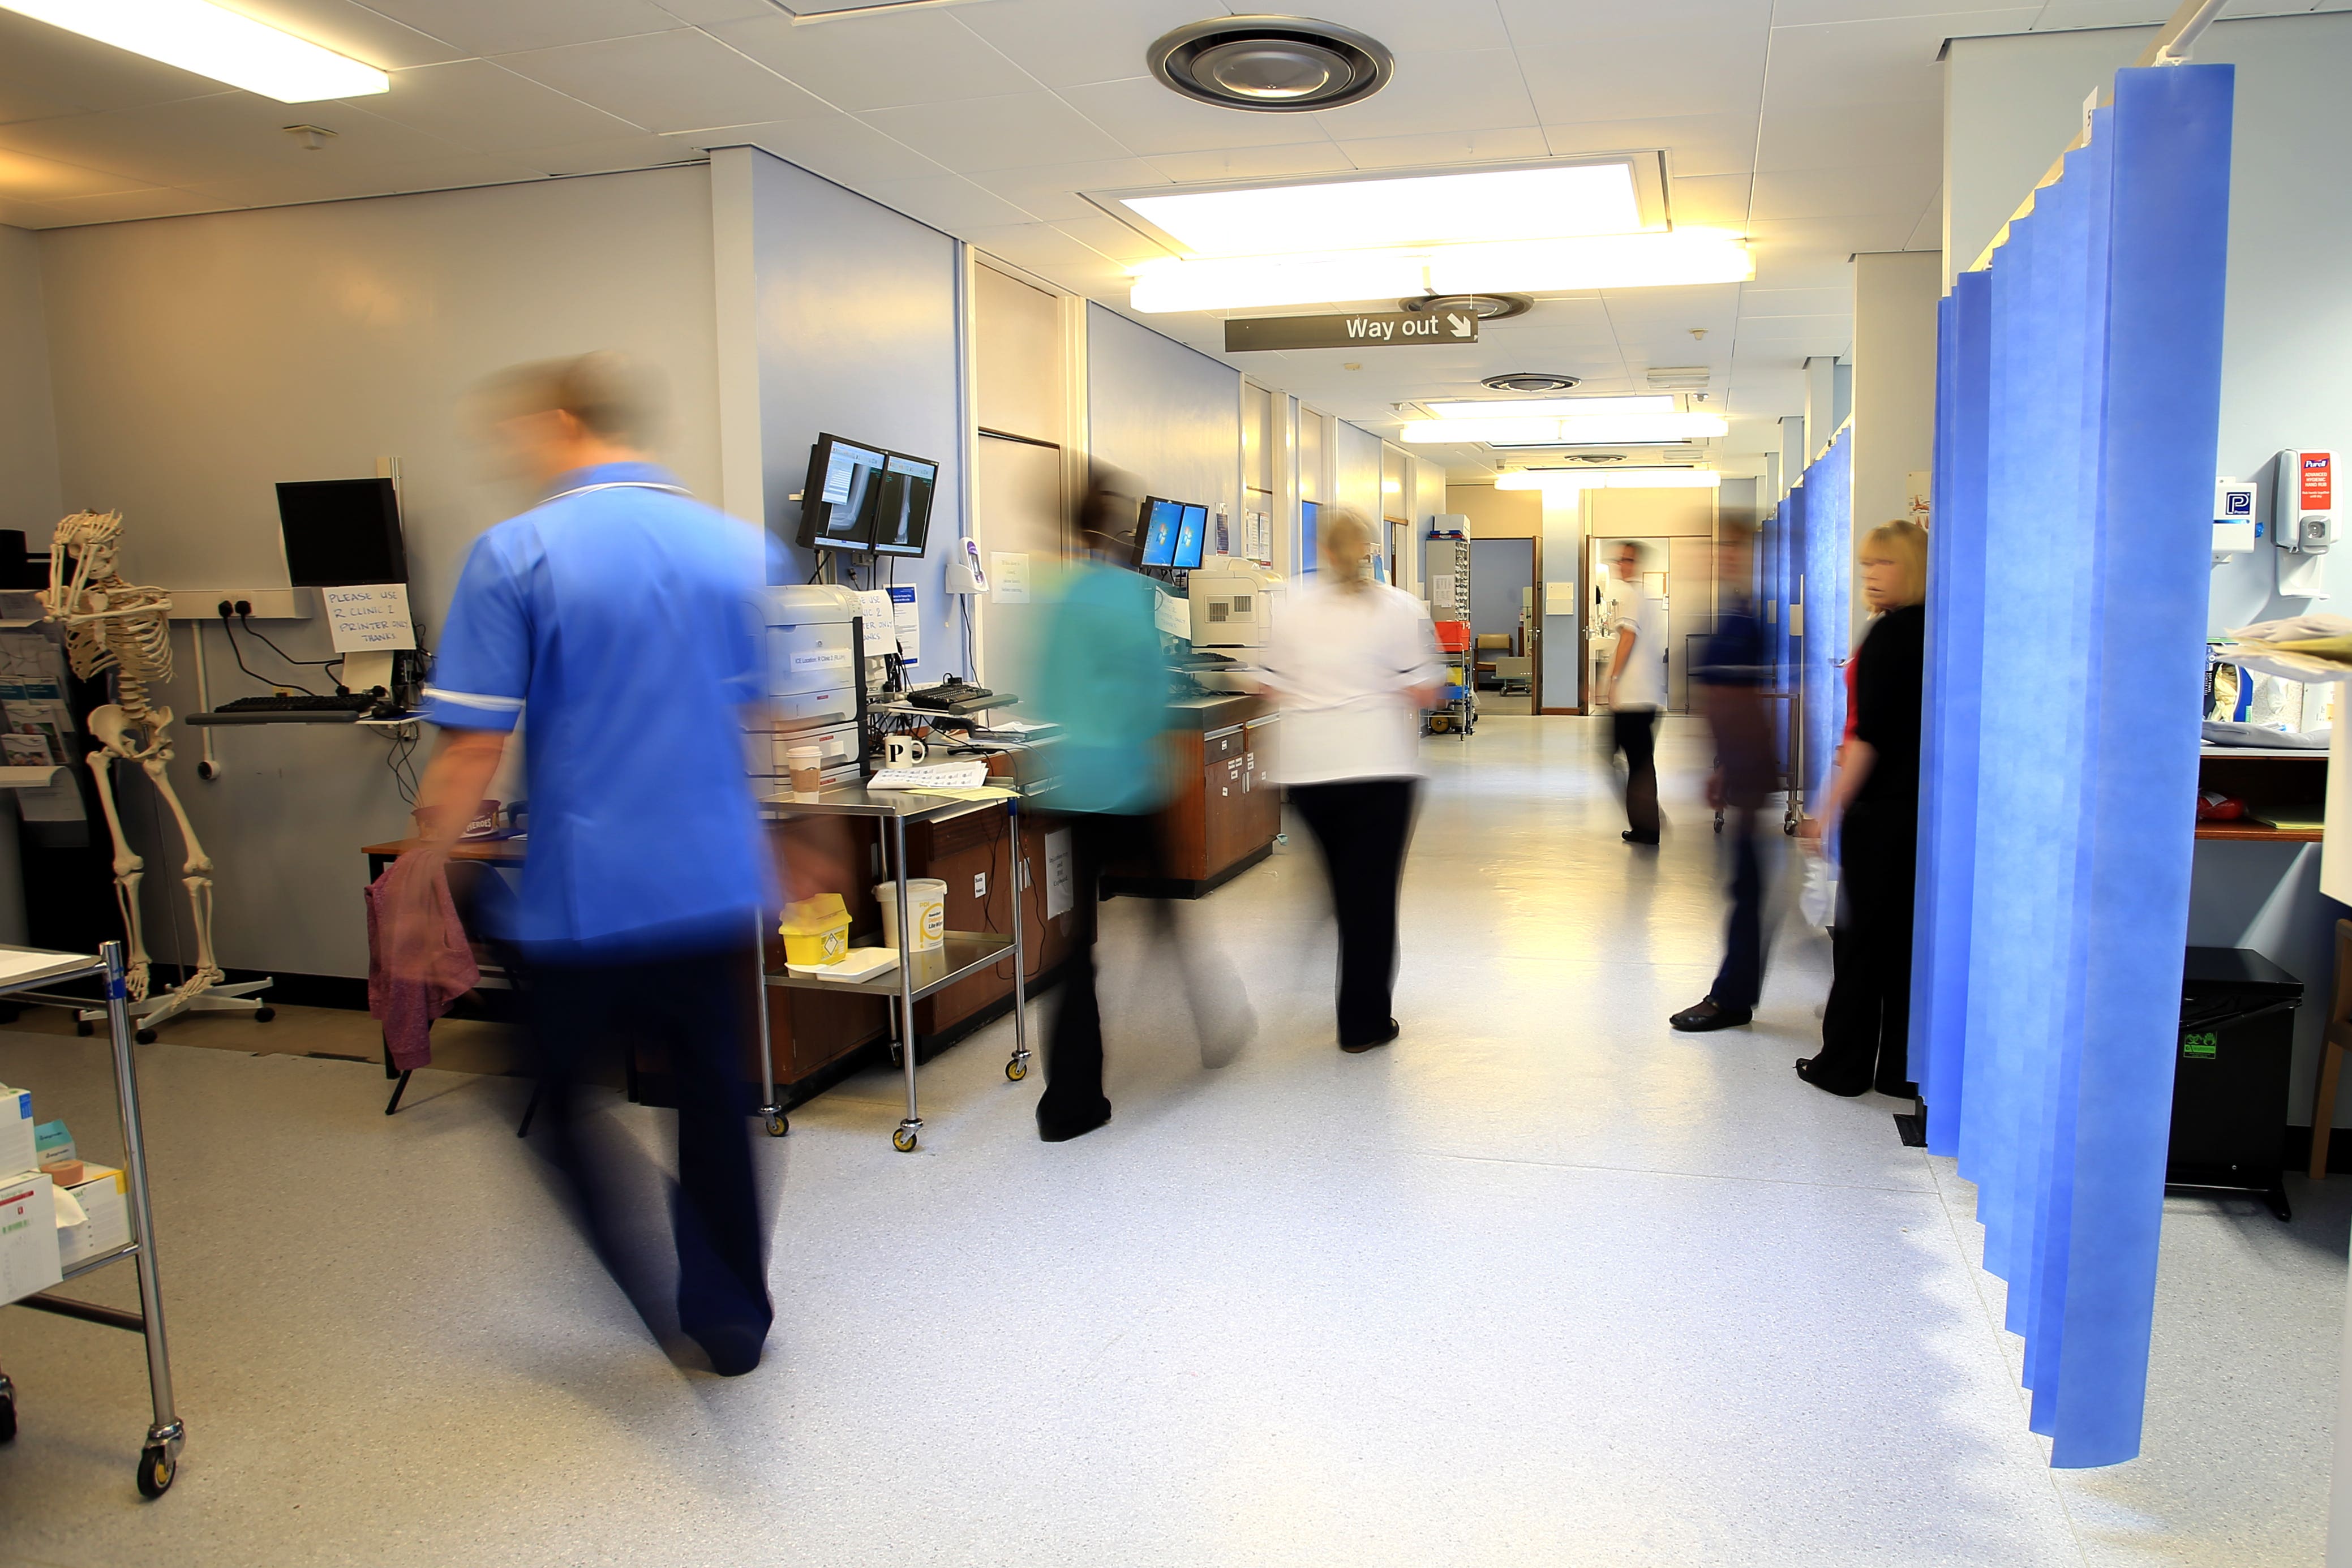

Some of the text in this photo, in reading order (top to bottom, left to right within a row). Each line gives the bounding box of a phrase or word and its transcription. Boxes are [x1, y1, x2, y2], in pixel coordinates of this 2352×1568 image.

[1346, 315, 1439, 341] Way out
[328, 591, 397, 603] PLEASE USE
[350, 605, 383, 616] CLINIC
[876, 607, 882, 617] 2
[339, 621, 389, 632] PRINTER
[888, 744, 903, 762] P
